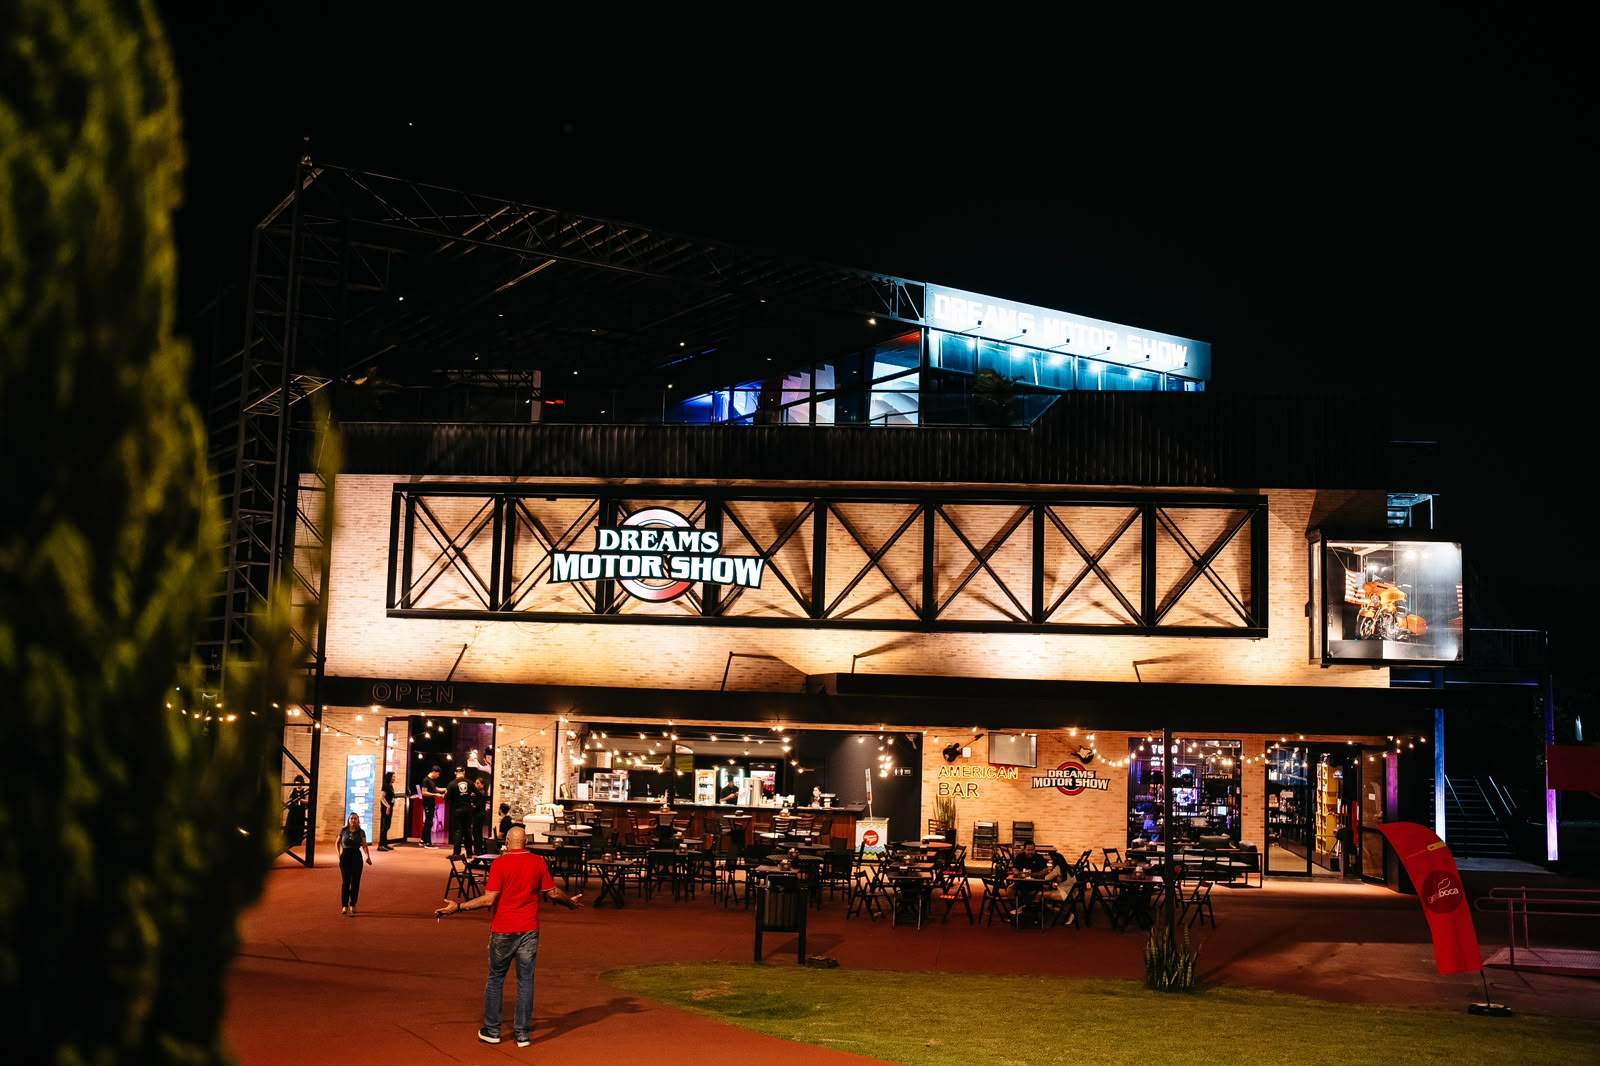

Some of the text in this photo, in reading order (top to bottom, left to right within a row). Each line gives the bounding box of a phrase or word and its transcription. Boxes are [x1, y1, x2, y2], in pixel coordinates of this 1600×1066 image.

[934, 293, 1187, 368] DREAMS MOTOR SHOW
[598, 529, 720, 553] DREAMS
[552, 553, 765, 588] MOTOR SHOW
[372, 683, 455, 705] OPEN
[938, 766, 1018, 780] AMERICAN
[1048, 769, 1095, 779] DREAMS
[938, 782, 979, 798] BAR
[1033, 778, 1110, 791] MOTOR SHOW
